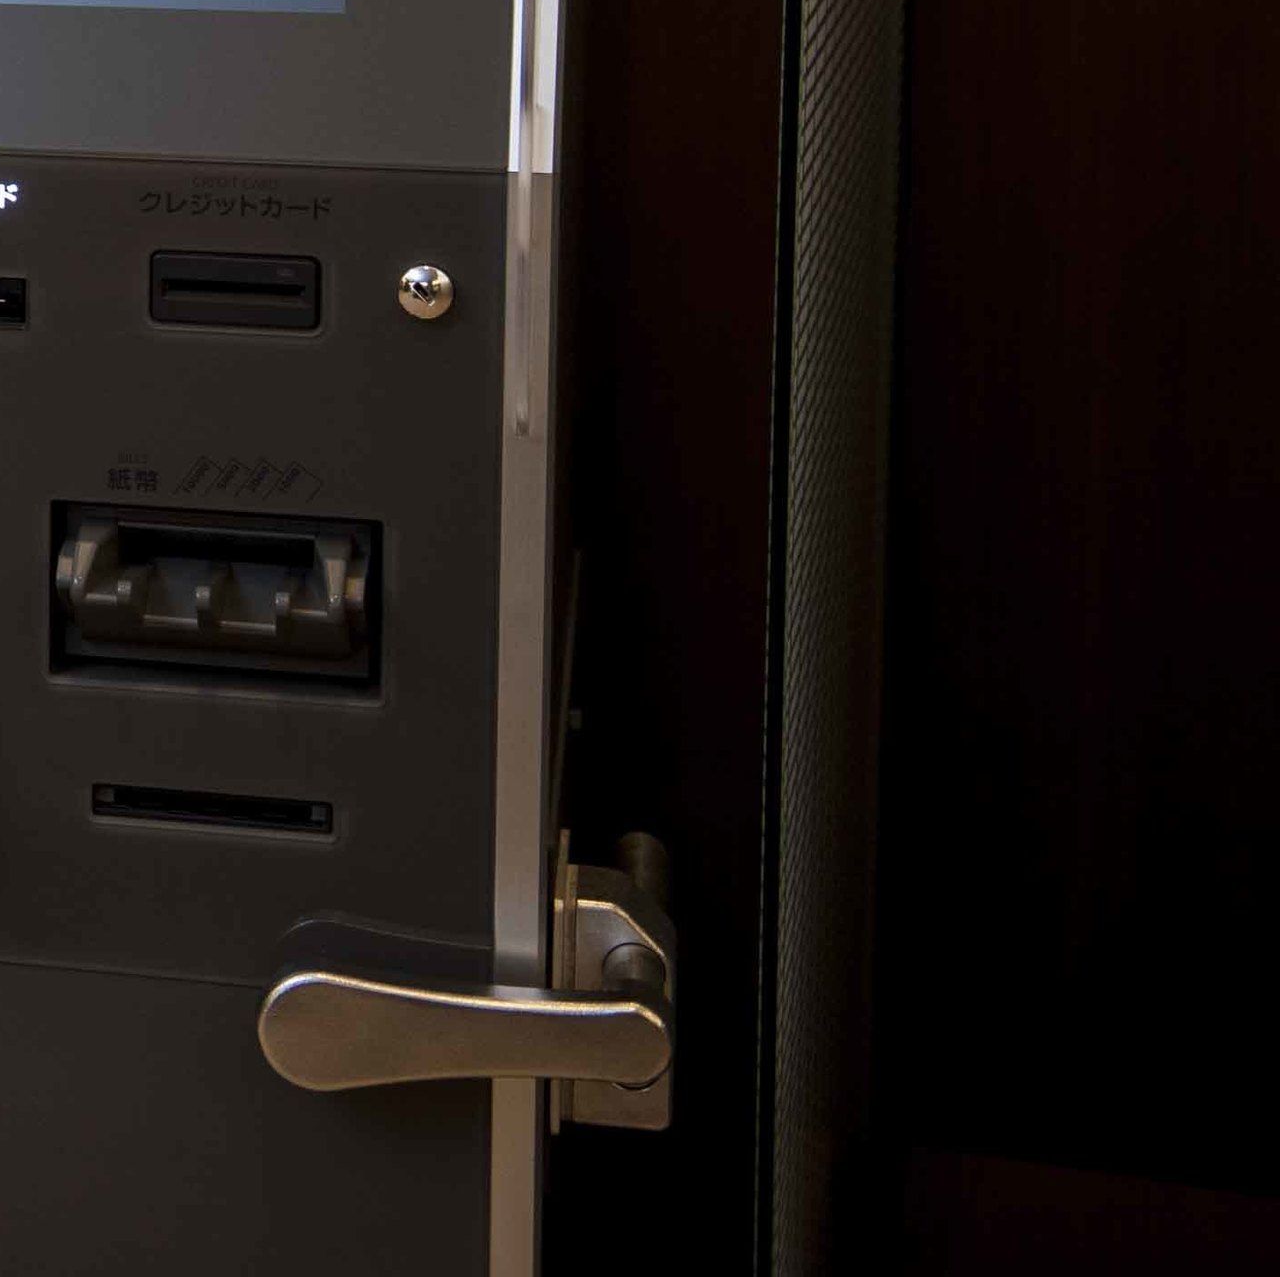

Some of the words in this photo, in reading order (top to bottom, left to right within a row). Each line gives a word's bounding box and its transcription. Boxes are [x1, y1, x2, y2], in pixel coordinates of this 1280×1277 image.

[139, 191, 333, 220] クレジットカード
